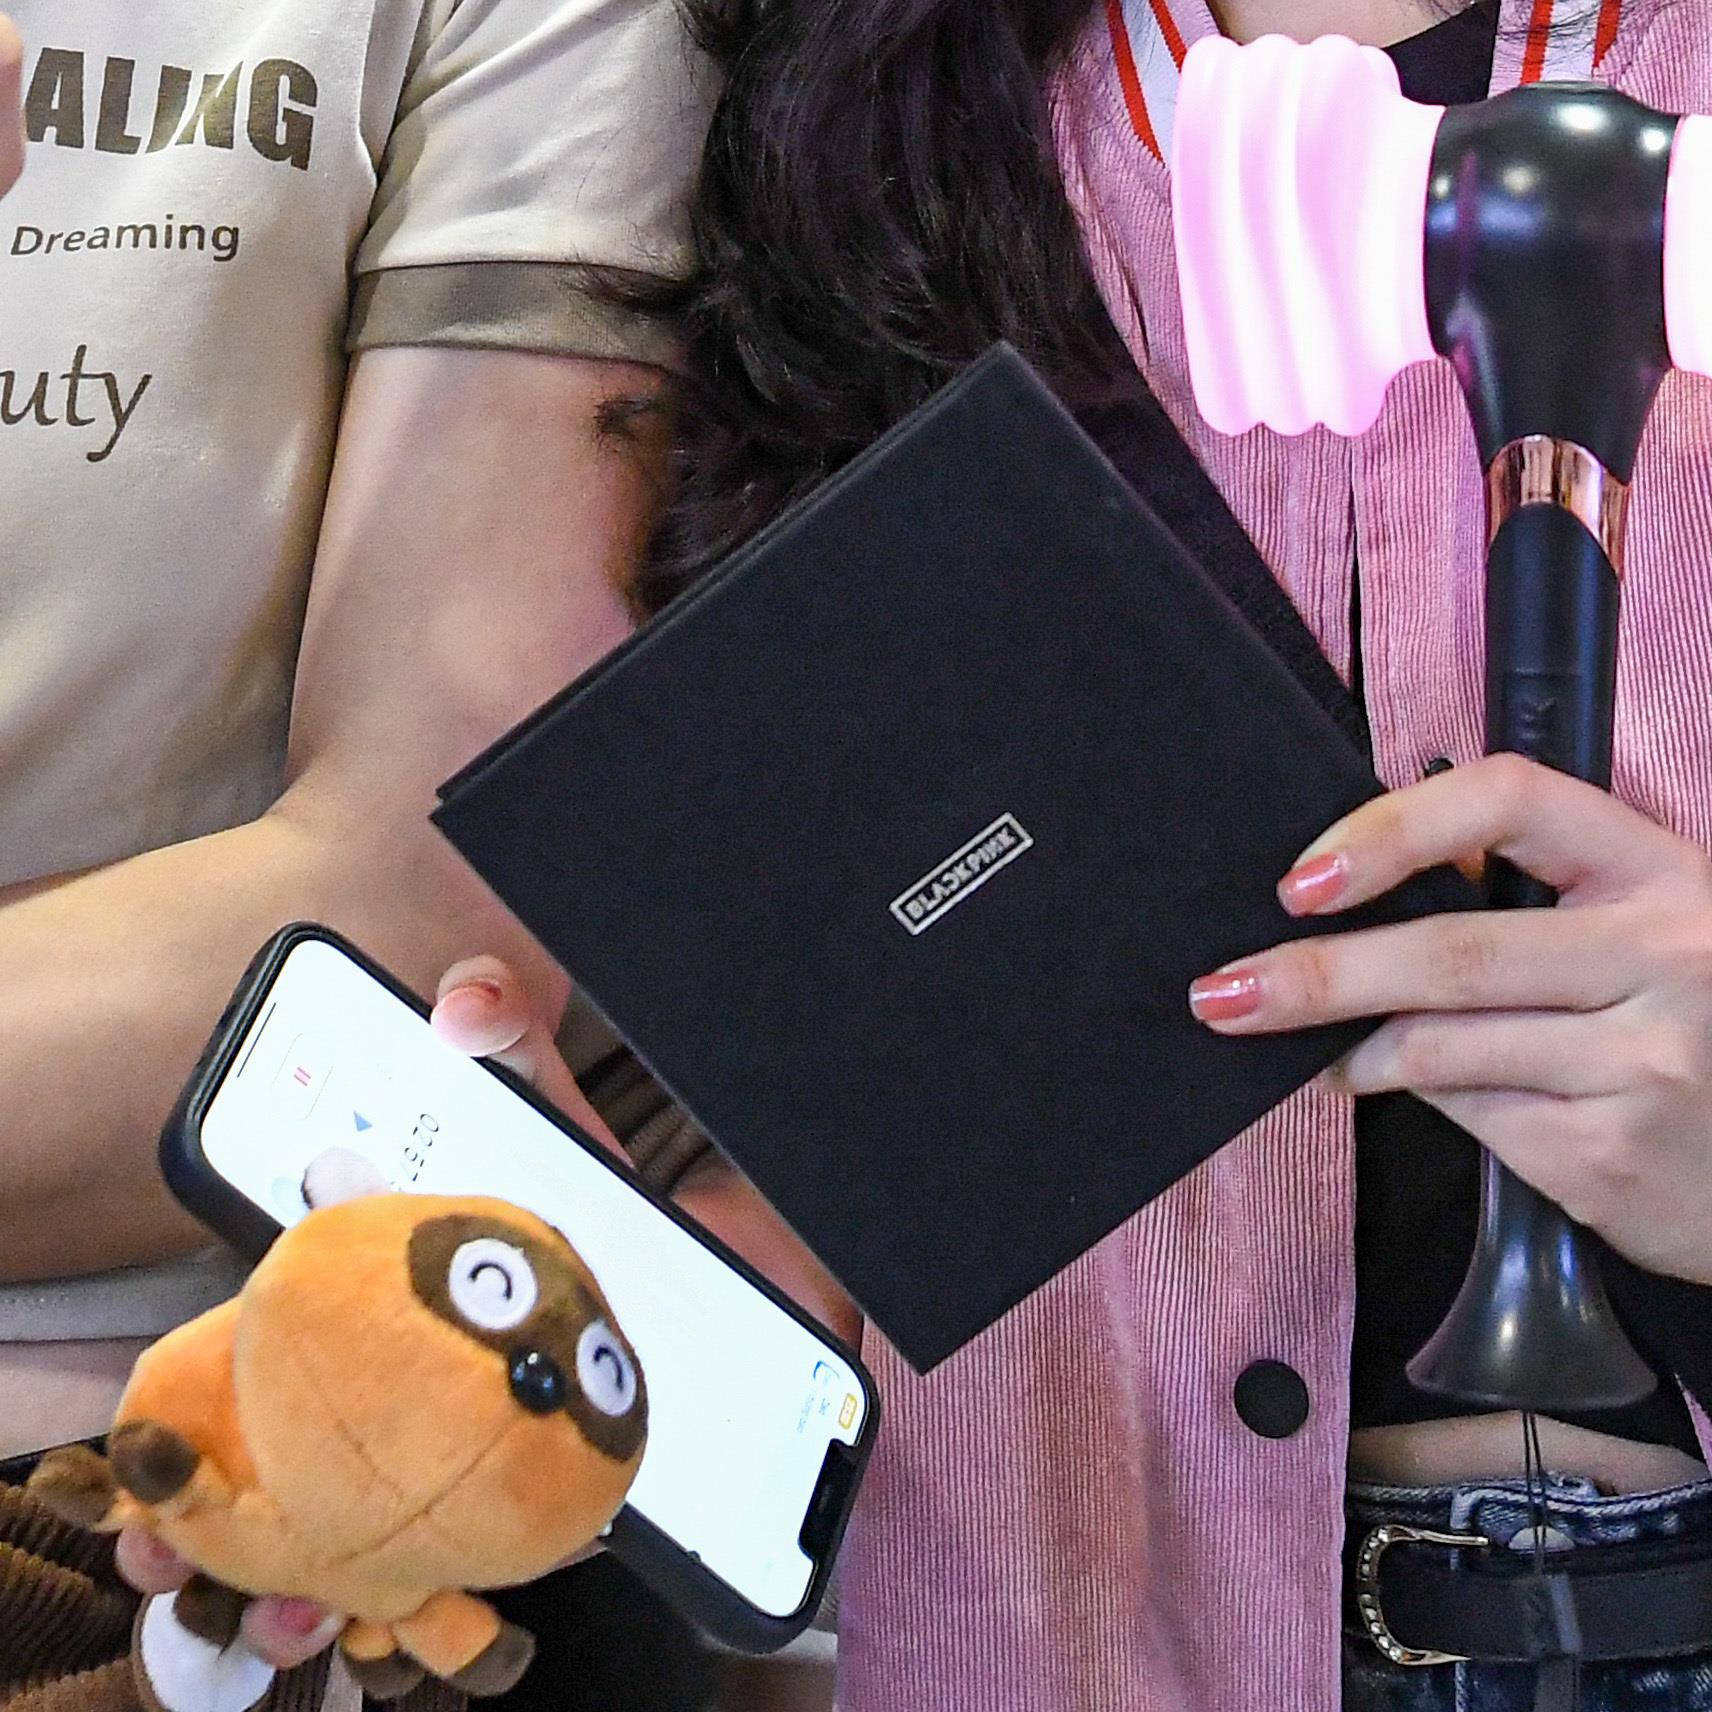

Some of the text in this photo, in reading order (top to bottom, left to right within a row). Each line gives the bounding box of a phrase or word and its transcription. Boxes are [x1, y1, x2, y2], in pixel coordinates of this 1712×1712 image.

[25, 47, 318, 171] ALING
[10, 214, 240, 262] Dreaming
[902, 825, 1018, 920] BLACKPINK
